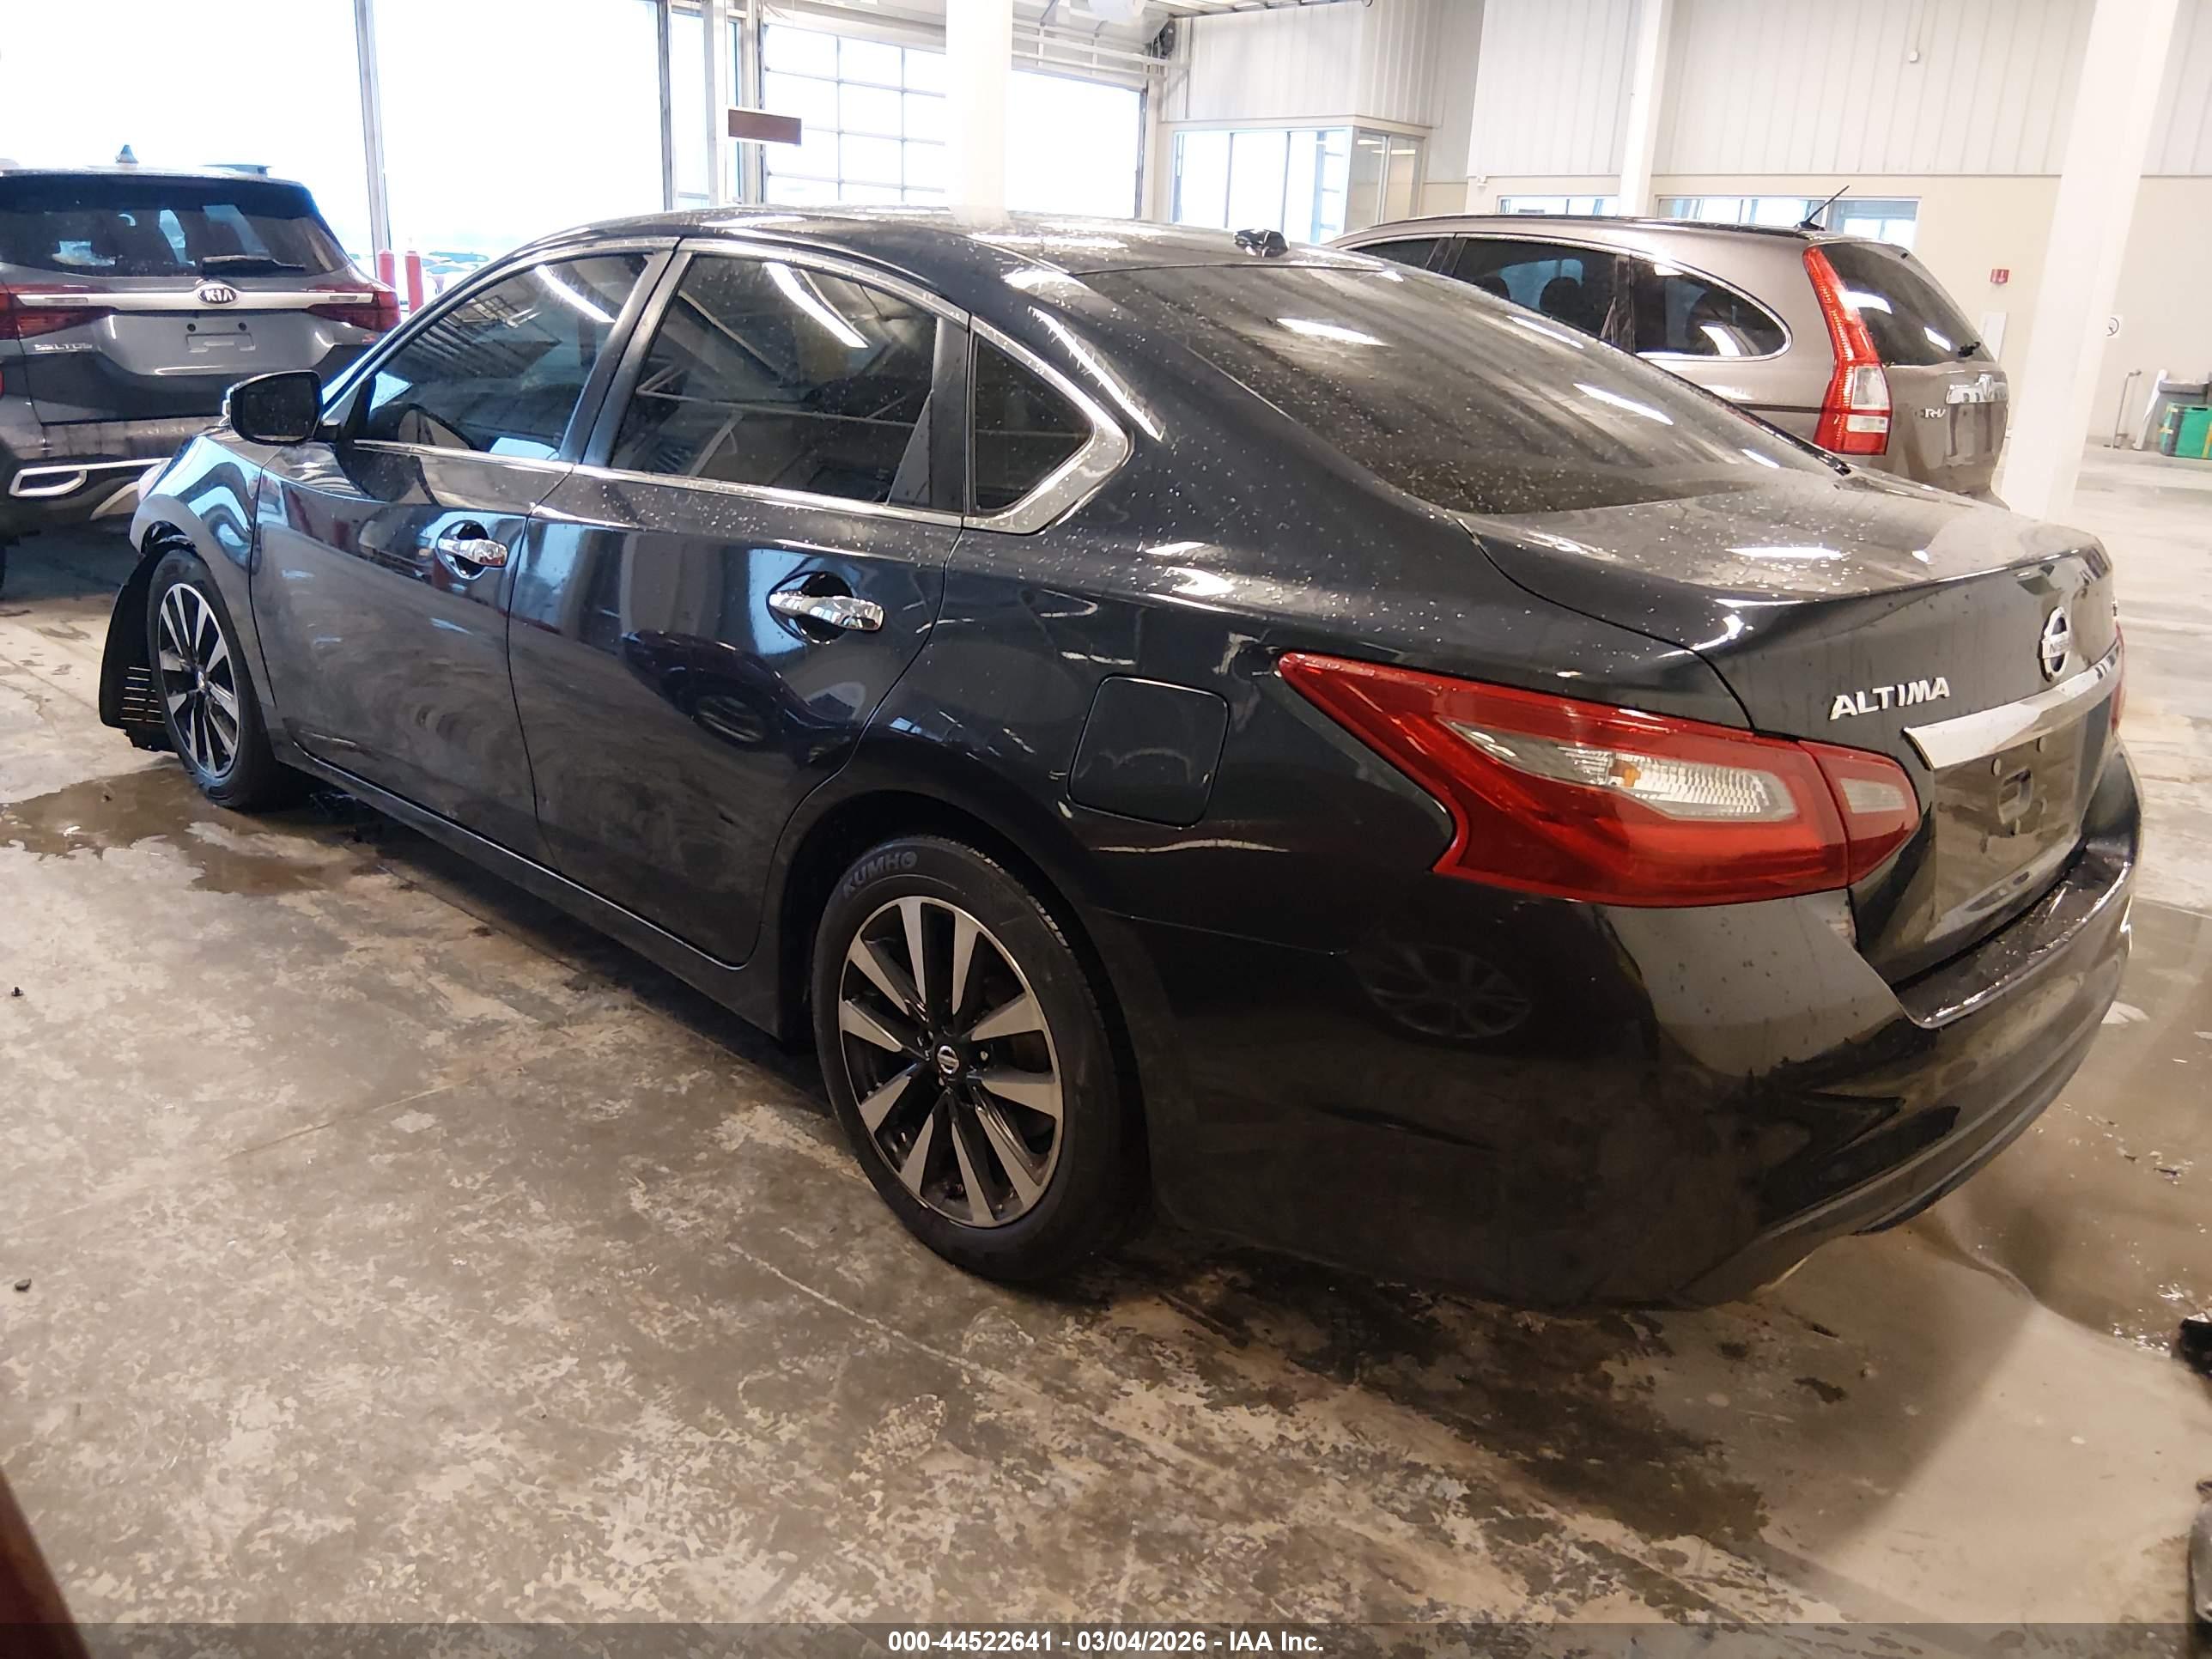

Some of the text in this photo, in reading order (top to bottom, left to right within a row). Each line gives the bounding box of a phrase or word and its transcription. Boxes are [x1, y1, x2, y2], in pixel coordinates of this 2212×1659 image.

[204, 288, 234, 301] KIA
[1829, 677, 1951, 720] ALTIMA
[842, 851, 919, 899] KUMHO
